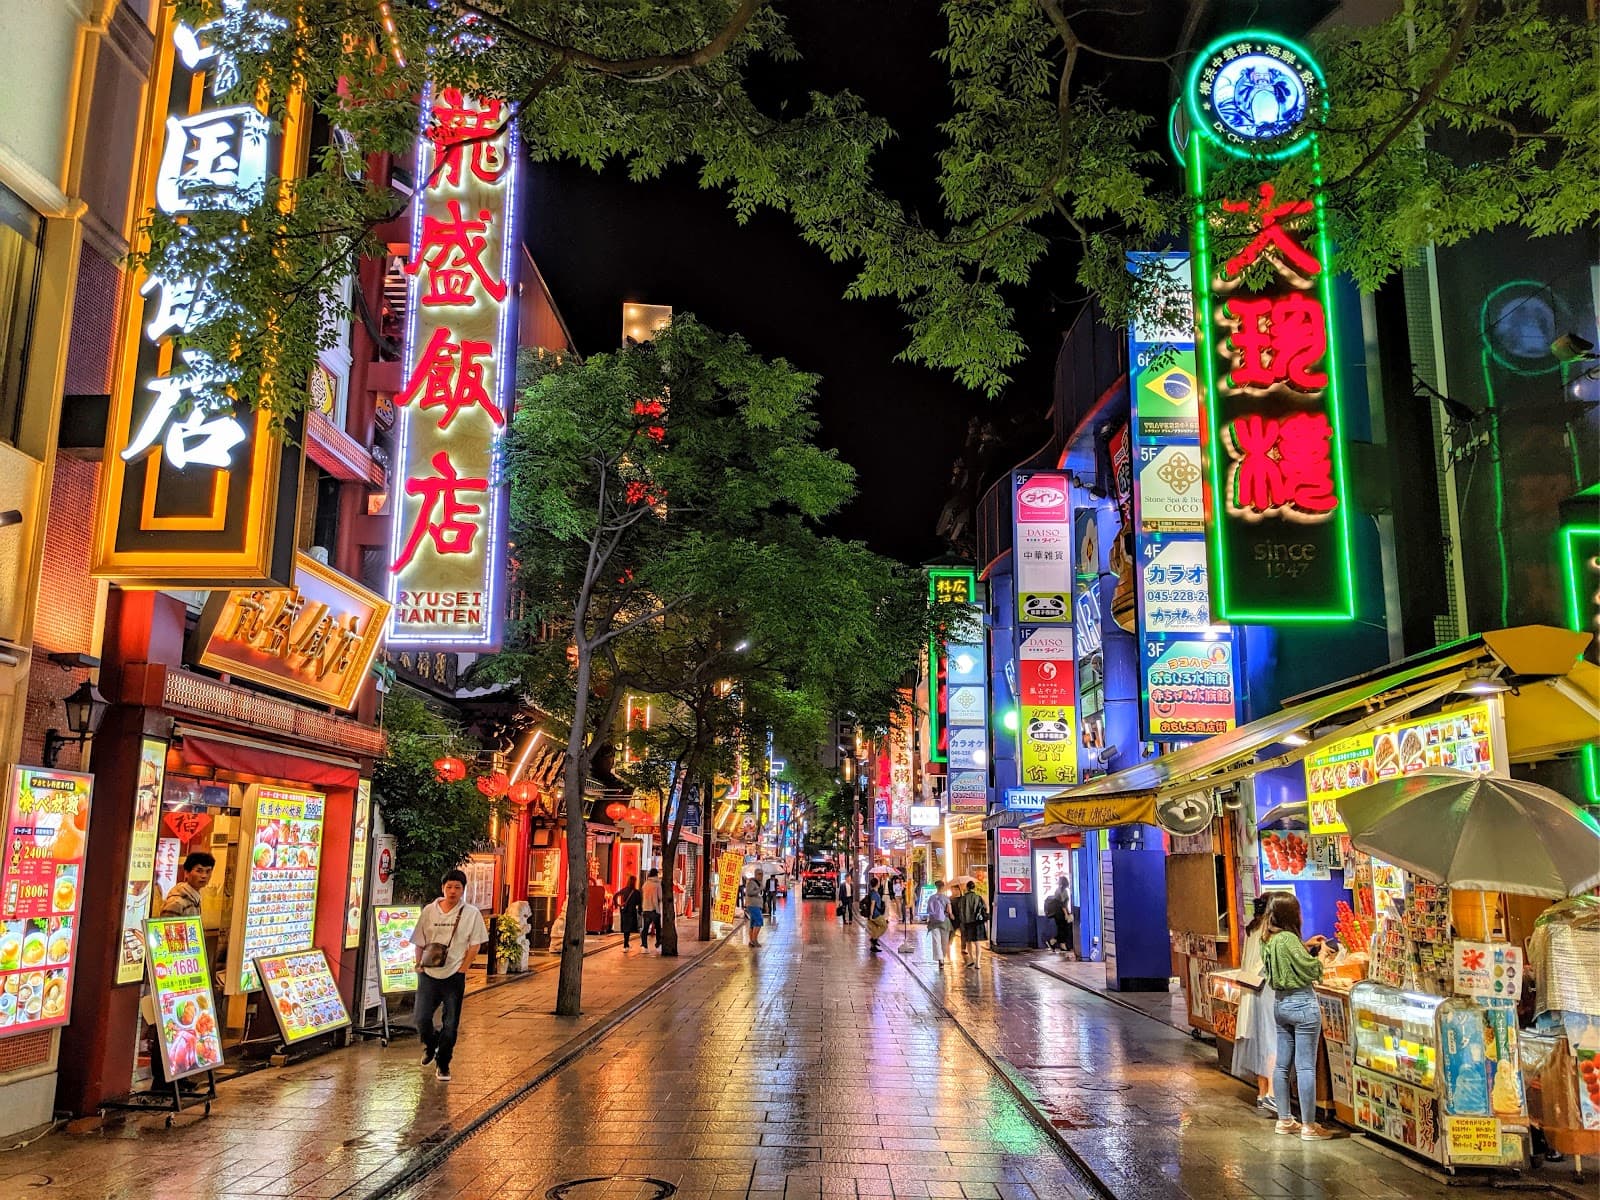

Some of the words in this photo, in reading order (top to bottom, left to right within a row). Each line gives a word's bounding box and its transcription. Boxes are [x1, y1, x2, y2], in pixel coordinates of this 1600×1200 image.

[1141, 447, 1158, 461] 5F
[1017, 475, 1028, 485] 2F
[1026, 493, 1062, 502] ダイソー
[1164, 504, 1199, 513] COCO
[1027, 529, 1060, 537] DAISO
[1144, 544, 1161, 559] 4F
[1254, 540, 1316, 561] since
[398, 591, 481, 607] RYUSEI
[398, 609, 481, 623] HANTEN
[1021, 630, 1031, 639] 1F
[1029, 639, 1063, 647] DAISO
[1147, 642, 1165, 658] 3F
[1168, 657, 1212, 670] ヨコハマ
[1151, 671, 1231, 687] おもしろ水族館
[1151, 688, 1231, 704] 赤ちゃん水族館
[1160, 721, 1228, 733] おもしろ商店街
[951, 739, 984, 749] カラオケ
[1026, 765, 1075, 783] 你好
[1041, 855, 1052, 895] スクエア
